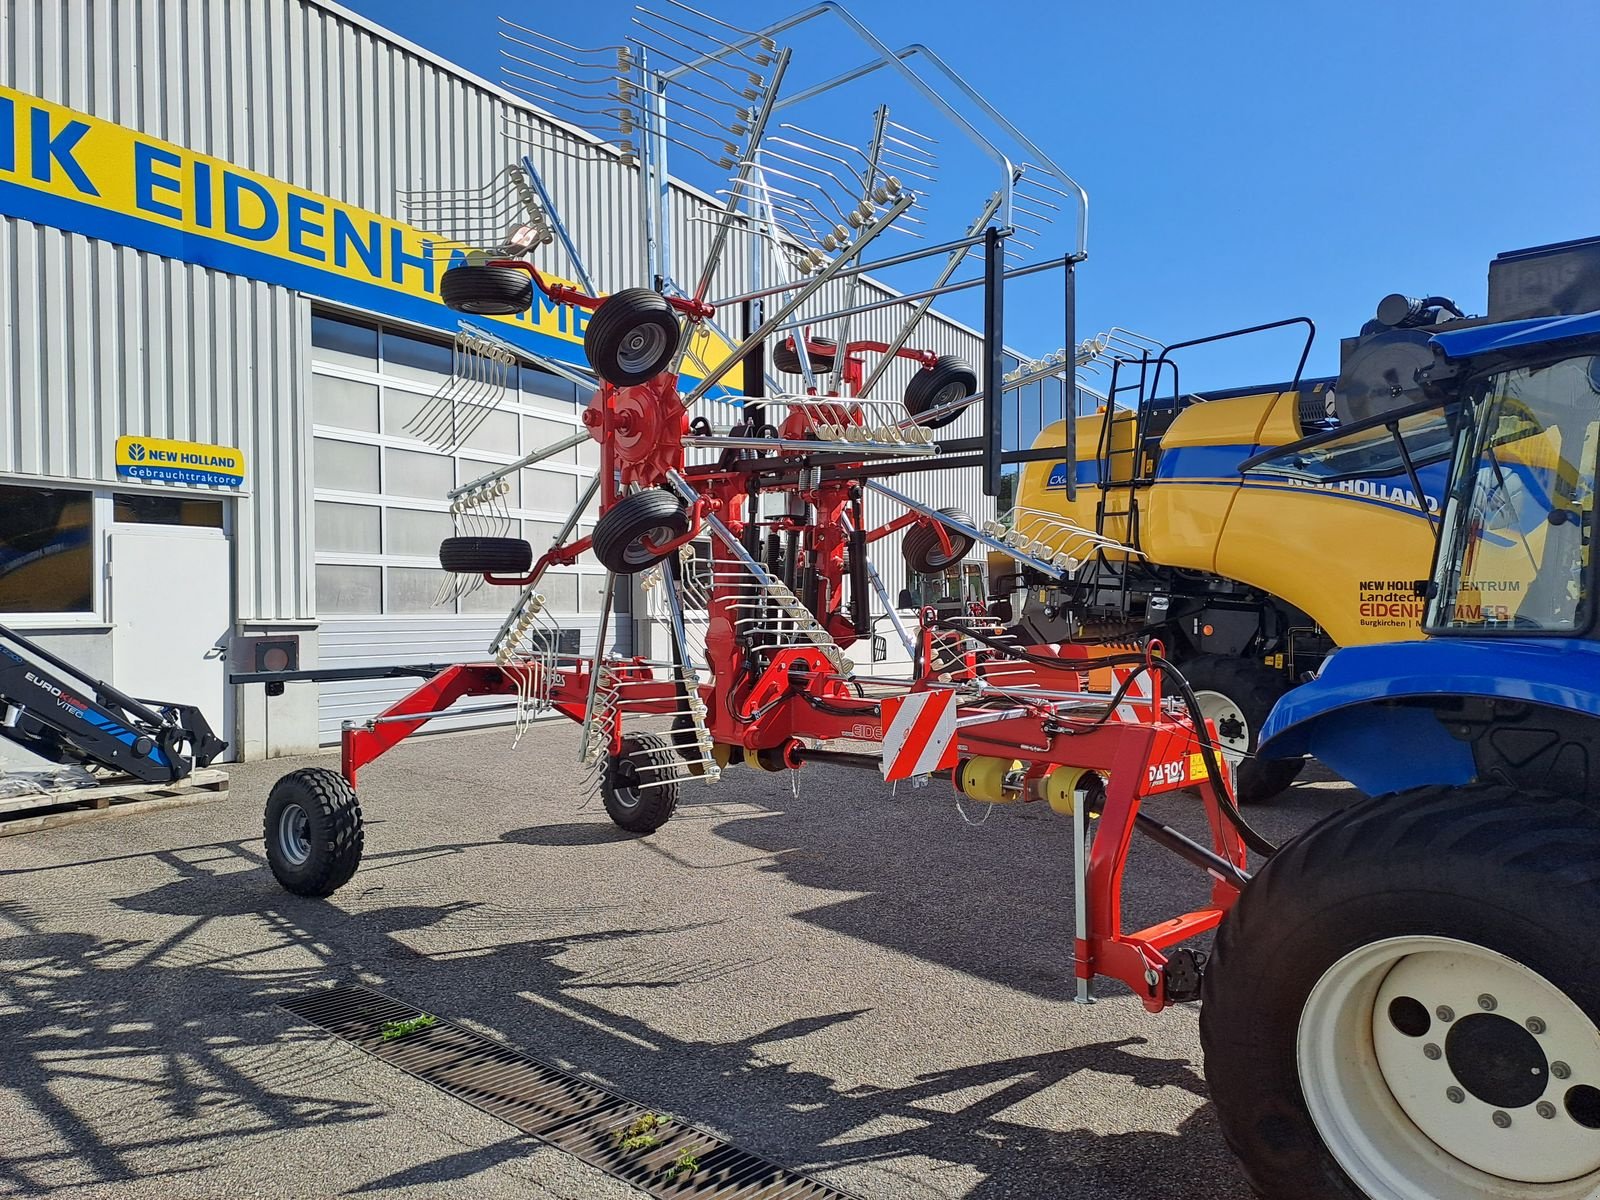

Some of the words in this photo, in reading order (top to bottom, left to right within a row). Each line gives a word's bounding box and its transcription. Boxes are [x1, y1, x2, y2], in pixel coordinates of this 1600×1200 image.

[149, 449, 178, 462] NEW
[181, 453, 235, 468] HOLLAND
[128, 466, 236, 485] Gebrauchttraktore
[1339, 479, 1439, 512] HOLLAND
[1359, 581, 1385, 591] NEW
[1455, 581, 1520, 592] ENTRUM
[1360, 619, 1406, 627] Burgkirchen
[1149, 760, 1185, 784] DAROS
